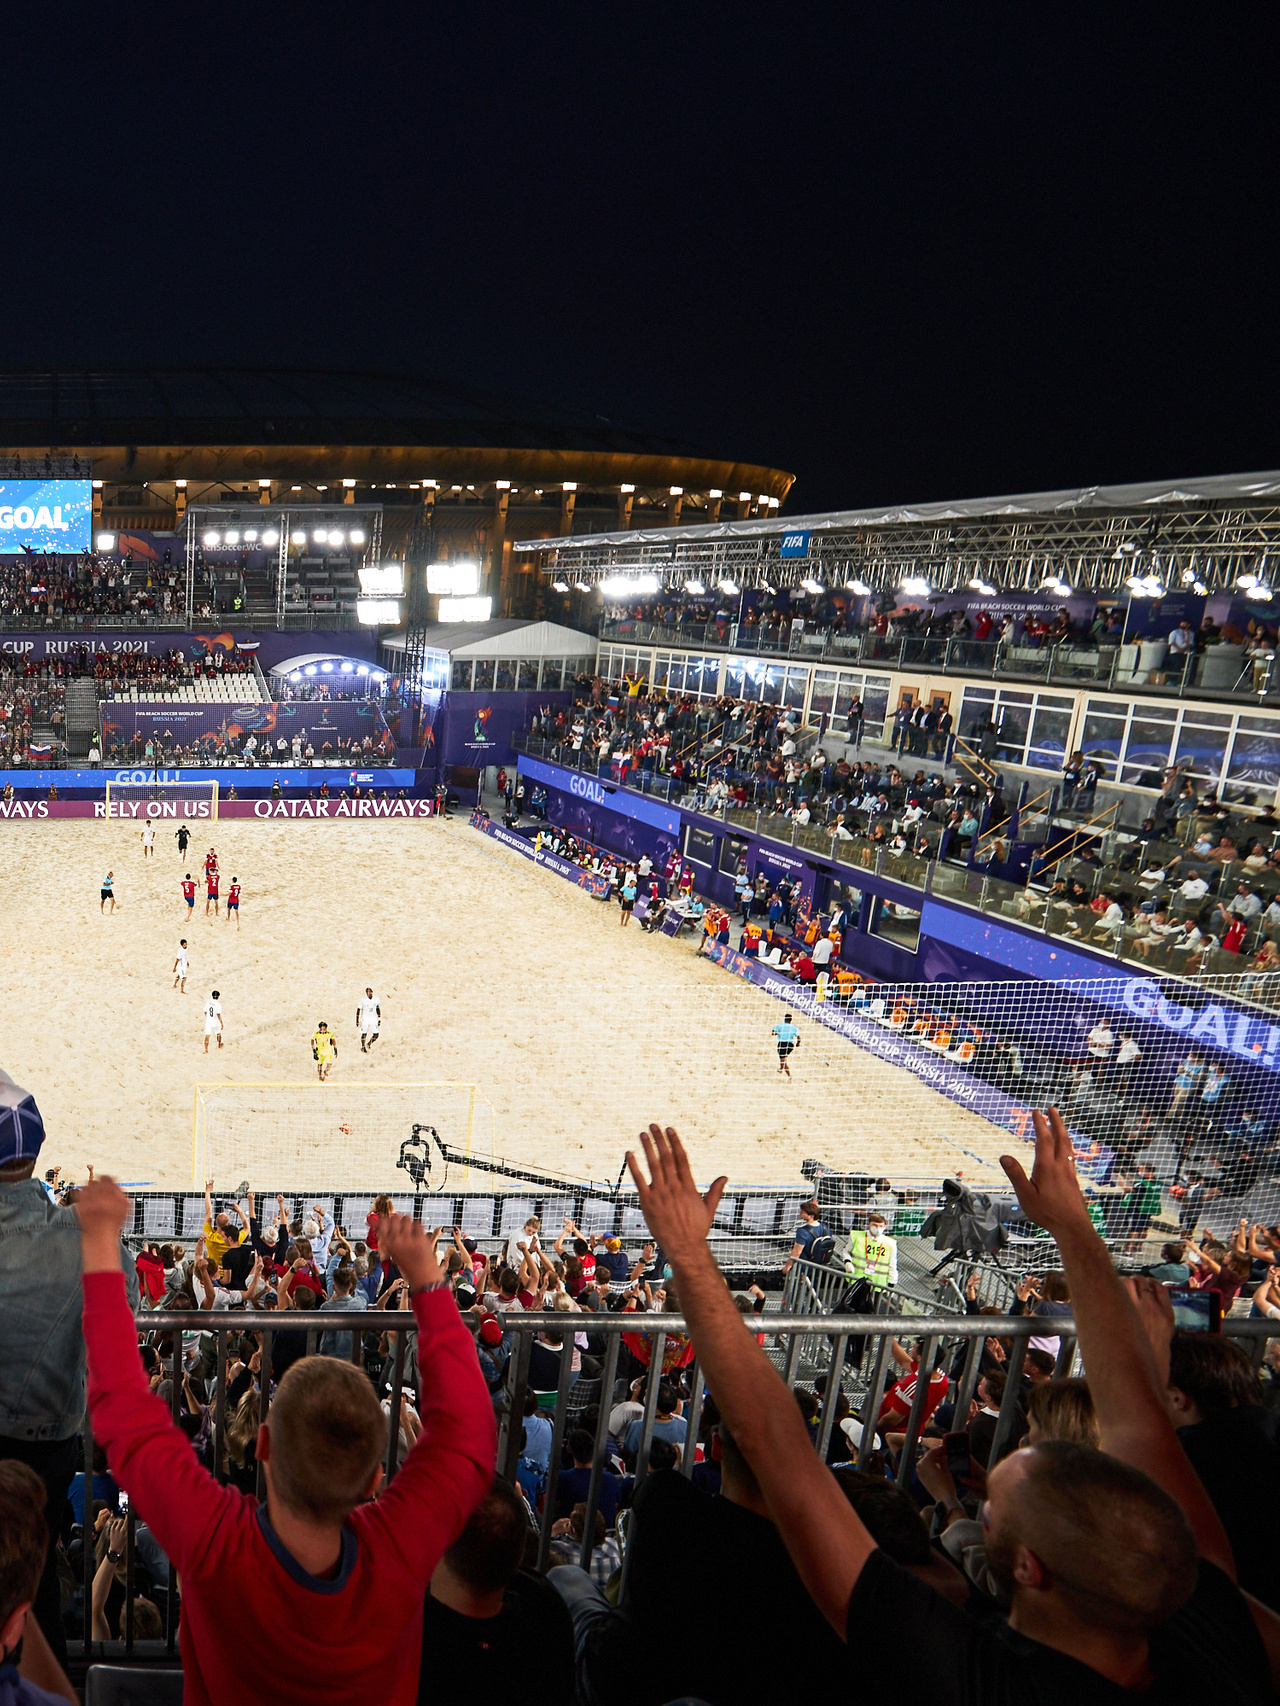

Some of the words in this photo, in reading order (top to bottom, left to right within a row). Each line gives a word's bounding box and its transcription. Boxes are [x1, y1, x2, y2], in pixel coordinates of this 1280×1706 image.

[782, 535, 804, 548] FIFA
[2, 641, 34, 654] CUP
[115, 770, 180, 785] GOAL!
[570, 774, 606, 804] GOAL!
[93, 801, 141, 817] RELY
[146, 801, 177, 817] ON
[184, 801, 210, 817] US
[254, 800, 330, 819] QATAR
[334, 800, 431, 818] AIRWAYS
[185, 885, 190, 893] 5
[212, 878, 217, 887] 2
[234, 889, 239, 897] 9
[209, 1006, 214, 1017] 8
[1123, 978, 1280, 1066] GOAL!
[764, 977, 782, 996] FIFA
[782, 987, 810, 1009] BEACH
[811, 1001, 844, 1029] SOCCER
[844, 1019, 879, 1047] WORLD
[878, 1037, 900, 1057] CUP
[904, 1054, 947, 1086] RUSSIA
[867, 1244, 886, 1257] 2152
